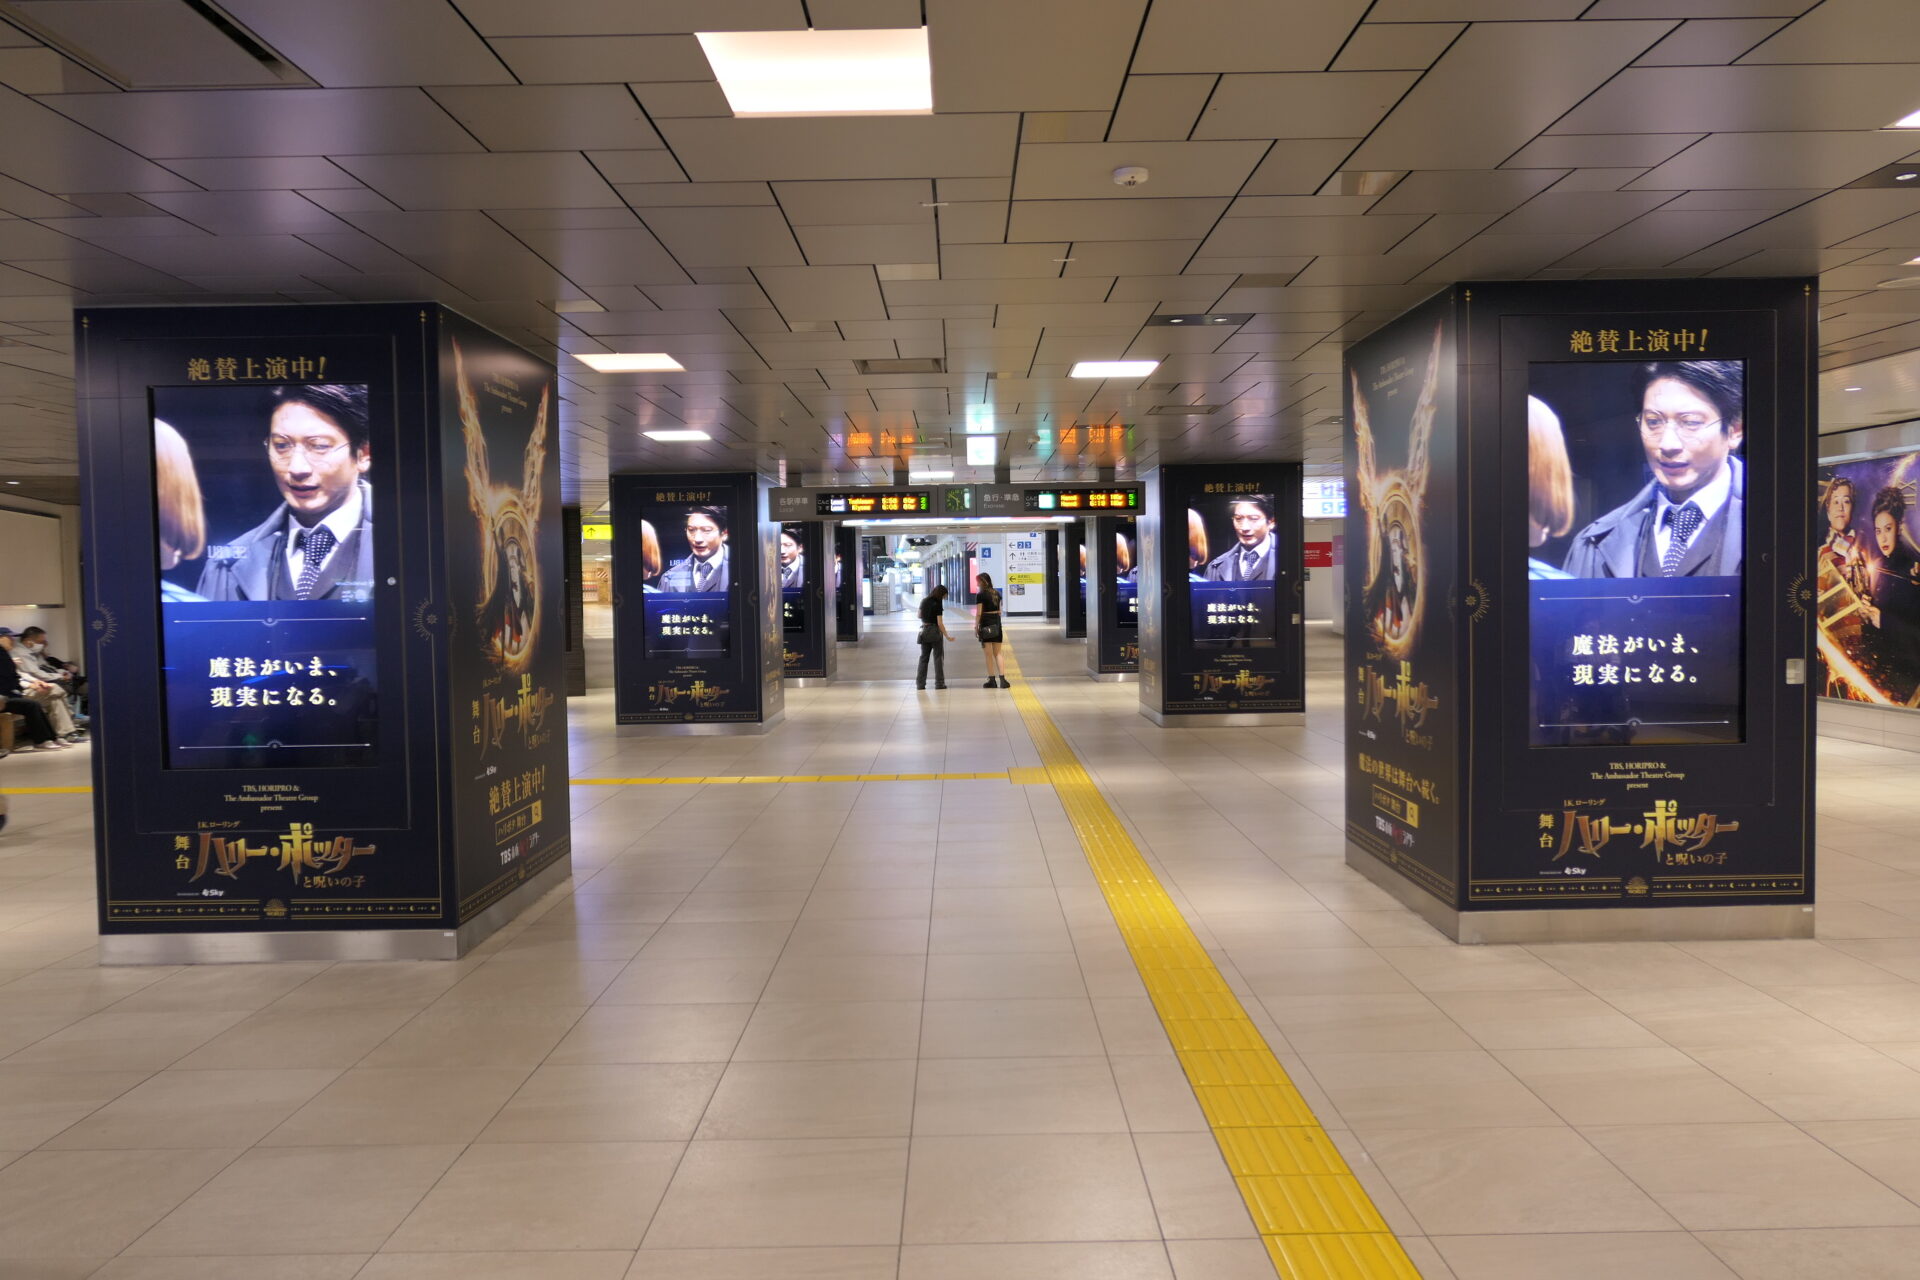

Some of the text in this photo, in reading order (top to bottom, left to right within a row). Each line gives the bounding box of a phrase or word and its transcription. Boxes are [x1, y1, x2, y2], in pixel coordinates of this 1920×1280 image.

[1570, 328, 1708, 353] 絶賛上演中!
[188, 356, 328, 381] 絶賛上演中!
[1572, 633, 1698, 655] 魔法がいま、
[209, 656, 338, 678] 魔法がいま、
[1572, 663, 1697, 685] 現実になる。
[210, 686, 336, 708] 現実になる。
[1665, 771, 1685, 780] Group
[298, 794, 319, 803] Group
[1539, 814, 1554, 848] 舞台
[1552, 800, 1739, 863] ハリー・ポッター
[174, 835, 190, 870] 舞台
[188, 822, 376, 886] ハリー・ポッター
[1666, 852, 1728, 866] と呪いの子
[303, 875, 366, 888] と呪いの子
